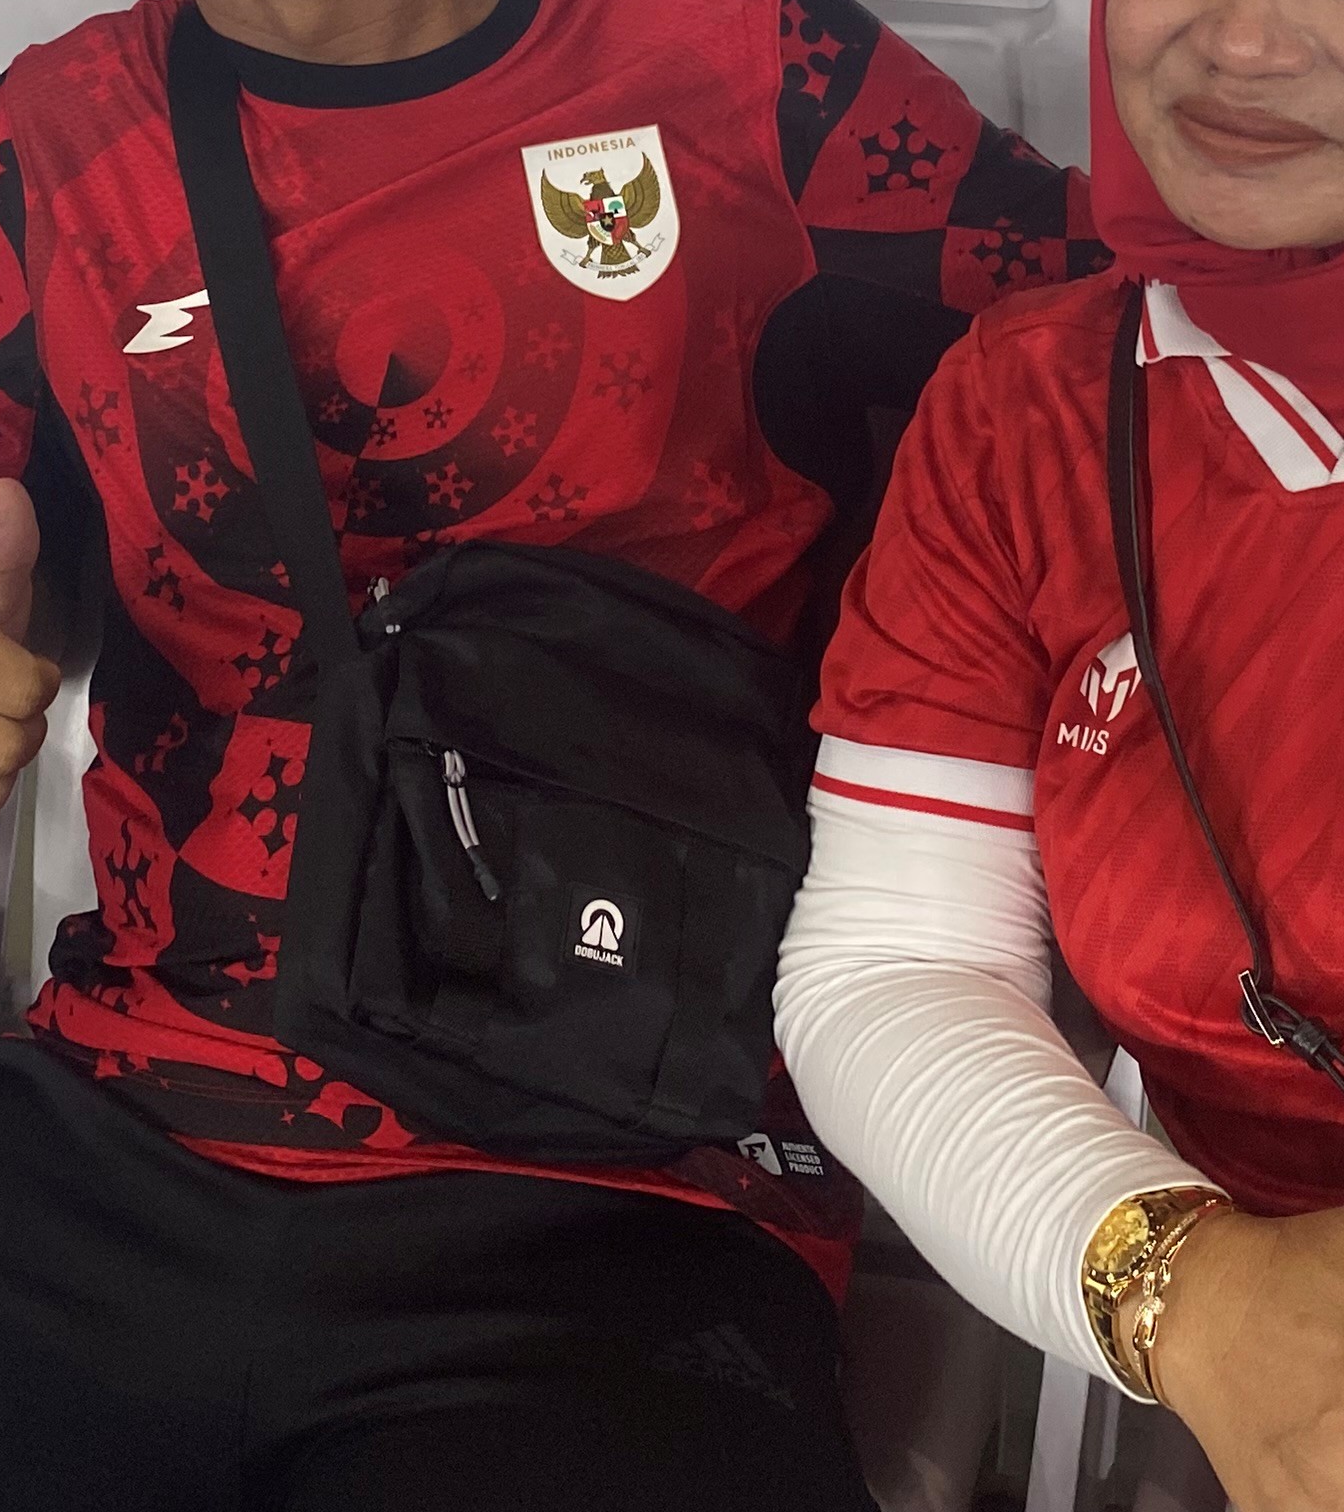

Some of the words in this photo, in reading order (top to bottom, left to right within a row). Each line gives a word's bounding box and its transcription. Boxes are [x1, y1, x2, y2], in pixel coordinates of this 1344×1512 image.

[545, 134, 638, 163] INDONESIA
[574, 944, 624, 967] DOBUJACK
[784, 1152, 821, 1165] LICENSED
[788, 1162, 824, 1176] PRODUCT
